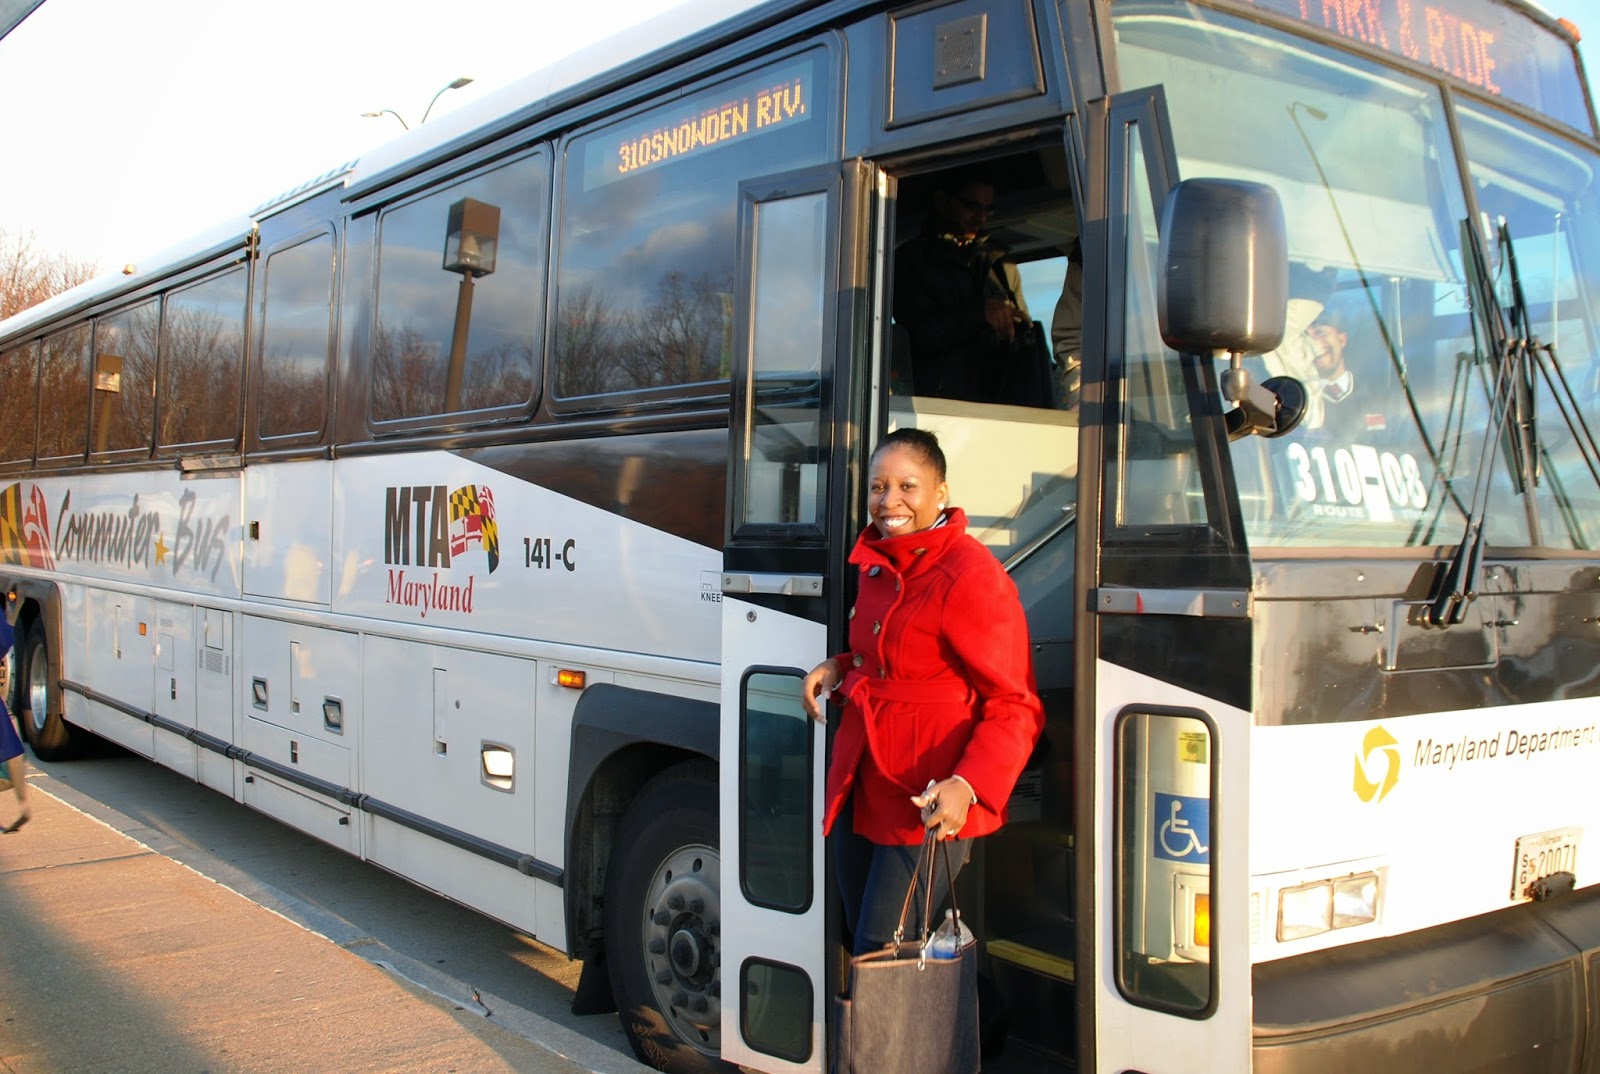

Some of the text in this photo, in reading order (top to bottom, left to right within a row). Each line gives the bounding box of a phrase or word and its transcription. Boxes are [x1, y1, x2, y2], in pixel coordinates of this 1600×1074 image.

[1300, 0, 1390, 50] ARK
[1424, 6, 1500, 95] RIDE
[756, 84, 806, 128] RIV.
[55, 487, 230, 583] Commuter Bus
[384, 485, 450, 569] MTA
[1313, 504, 1365, 519] ROUTE
[523, 537, 576, 572] 141-C
[386, 569, 474, 618] Maryland
[1414, 724, 1596, 772] Maryland Department
